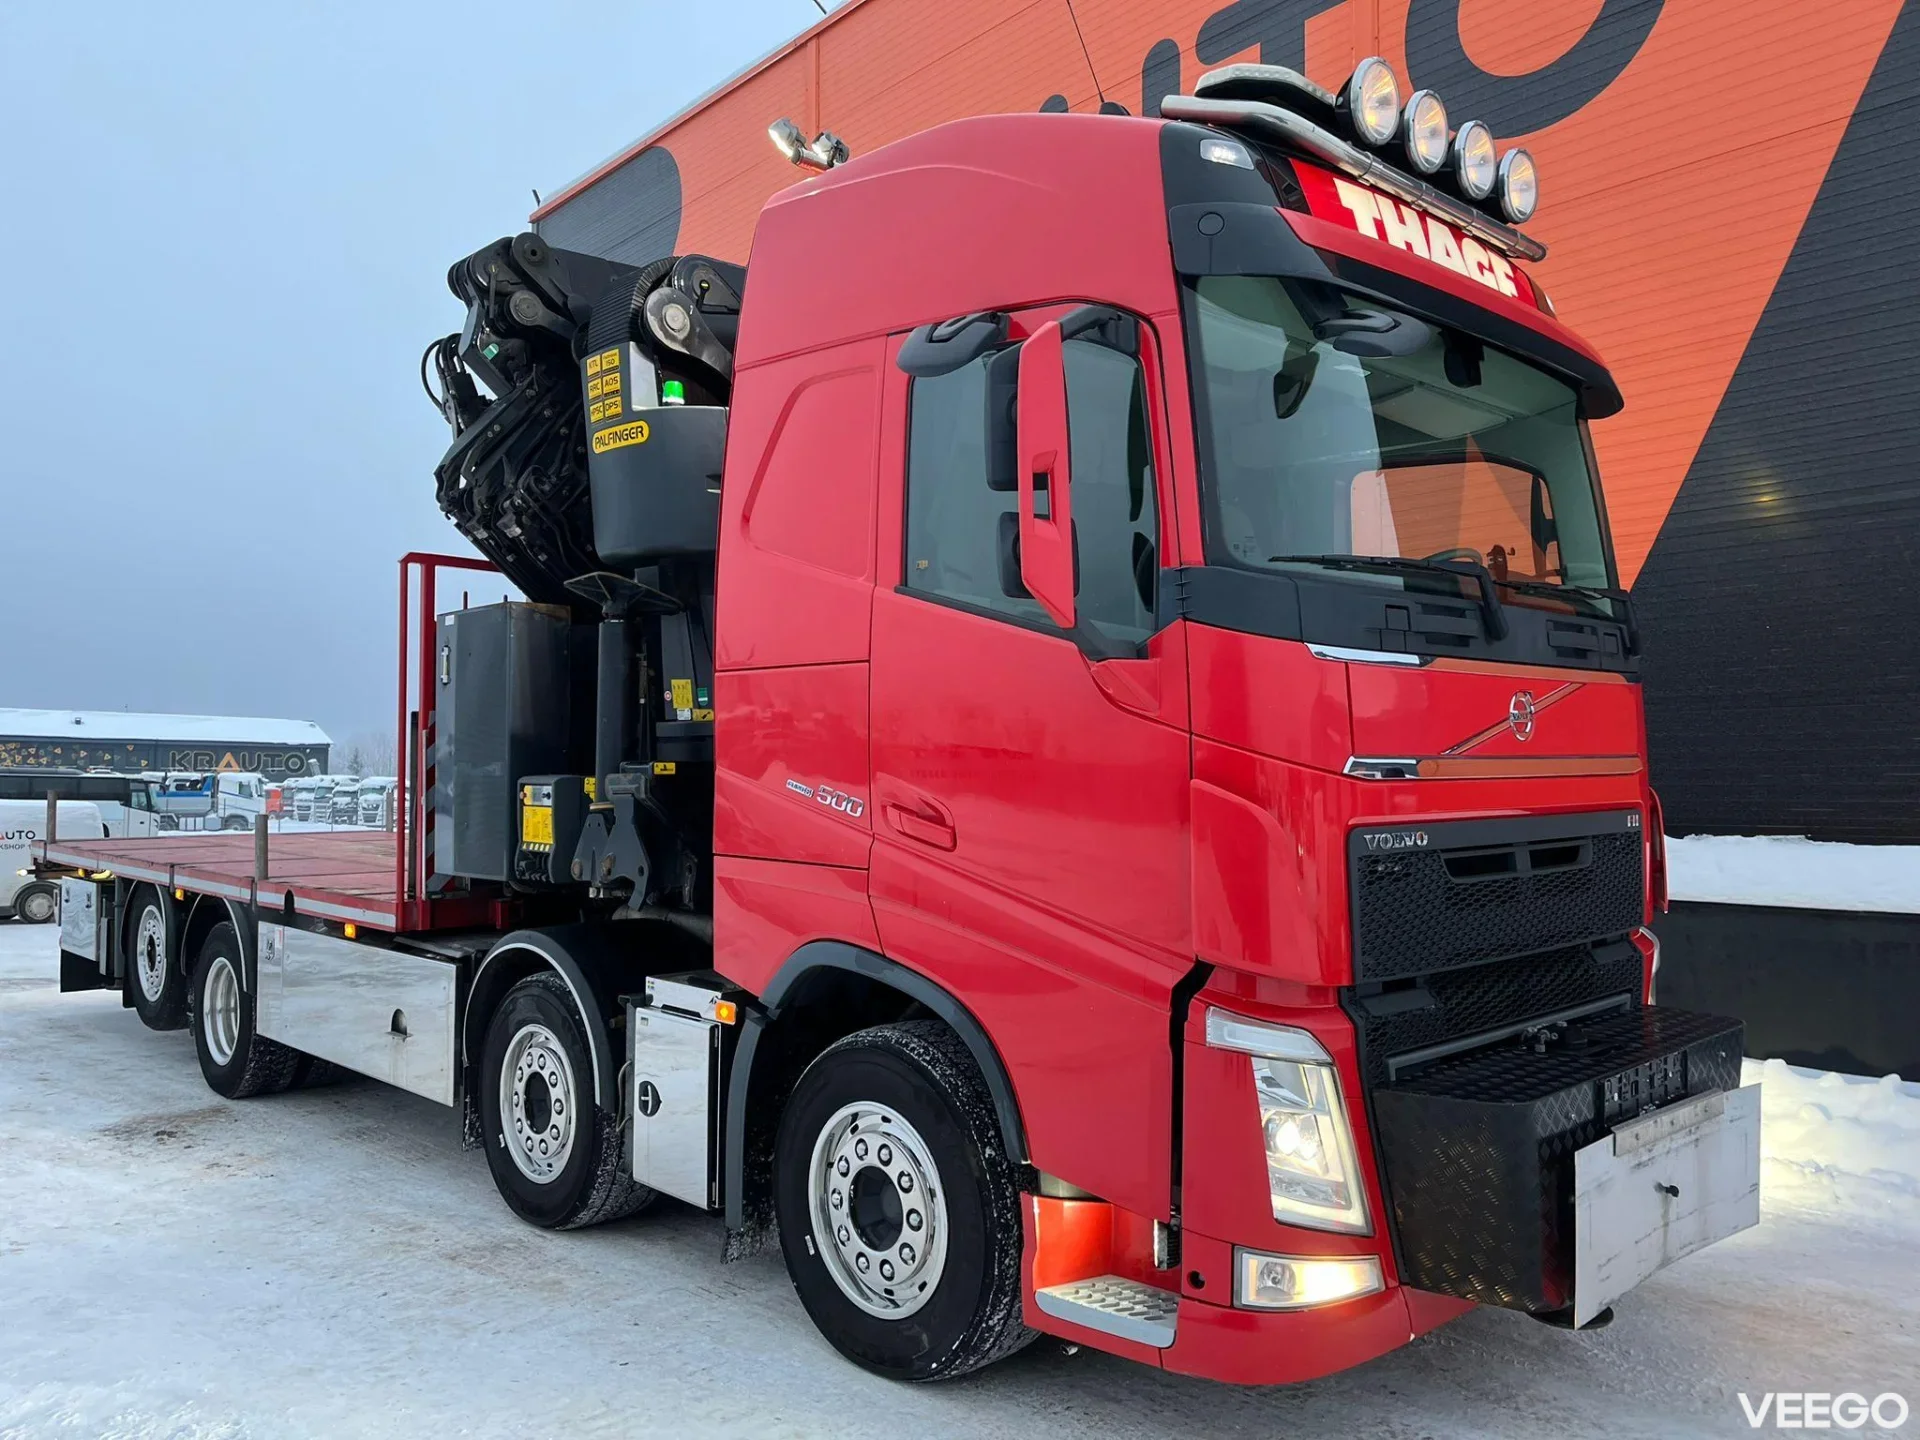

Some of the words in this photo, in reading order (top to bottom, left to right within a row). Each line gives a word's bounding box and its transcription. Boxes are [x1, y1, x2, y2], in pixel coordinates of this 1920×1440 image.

[594, 425, 645, 450] PALFINGER
[816, 784, 864, 818] 500
[1363, 831, 1429, 851] VOLVO
